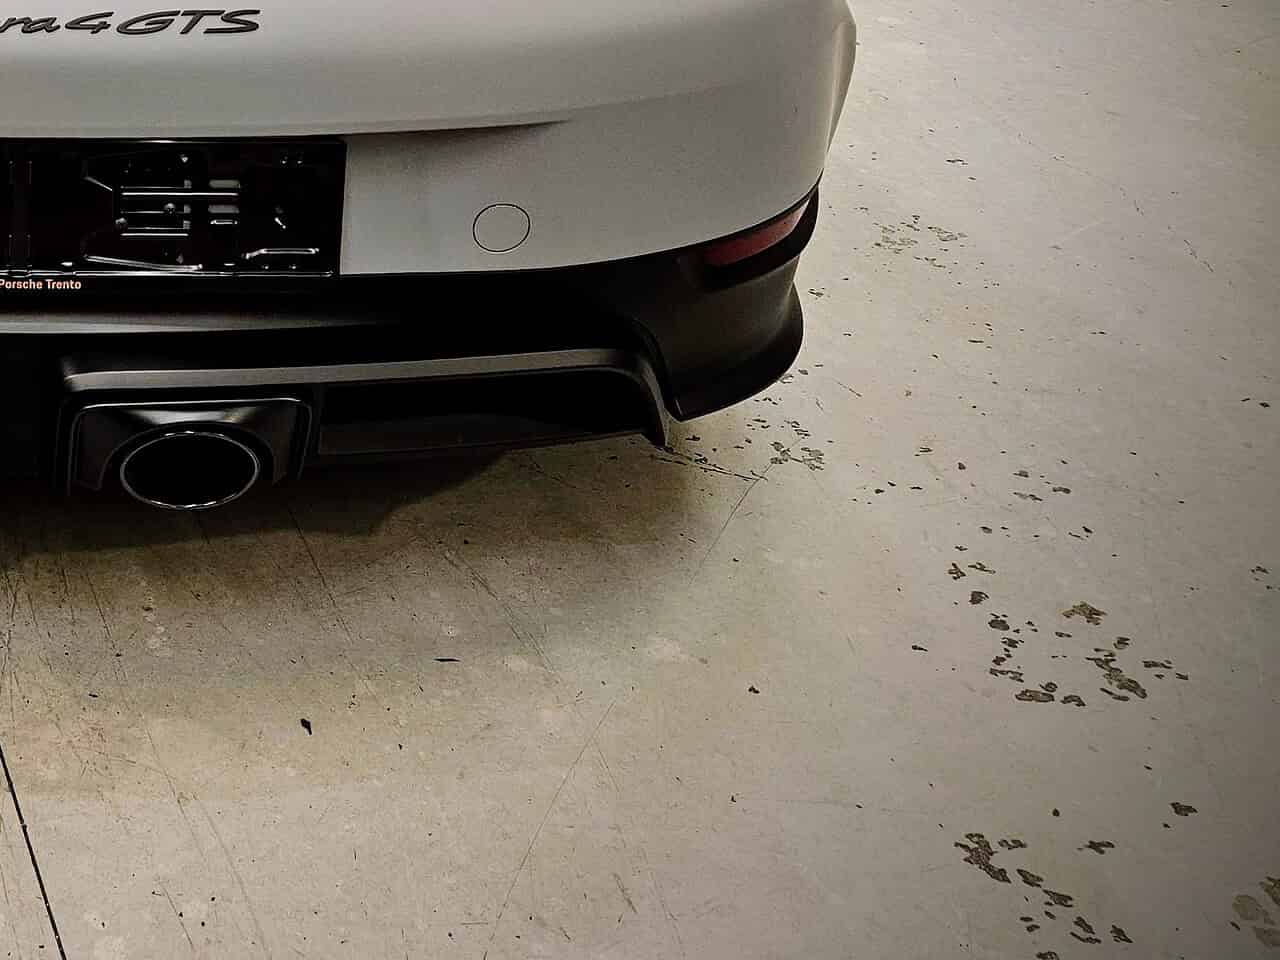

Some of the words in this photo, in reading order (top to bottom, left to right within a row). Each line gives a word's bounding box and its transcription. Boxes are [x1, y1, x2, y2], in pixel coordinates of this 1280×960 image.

[65, 11, 115, 35] 4
[116, 9, 261, 35] GTS
[45, 279, 82, 290] Trento
